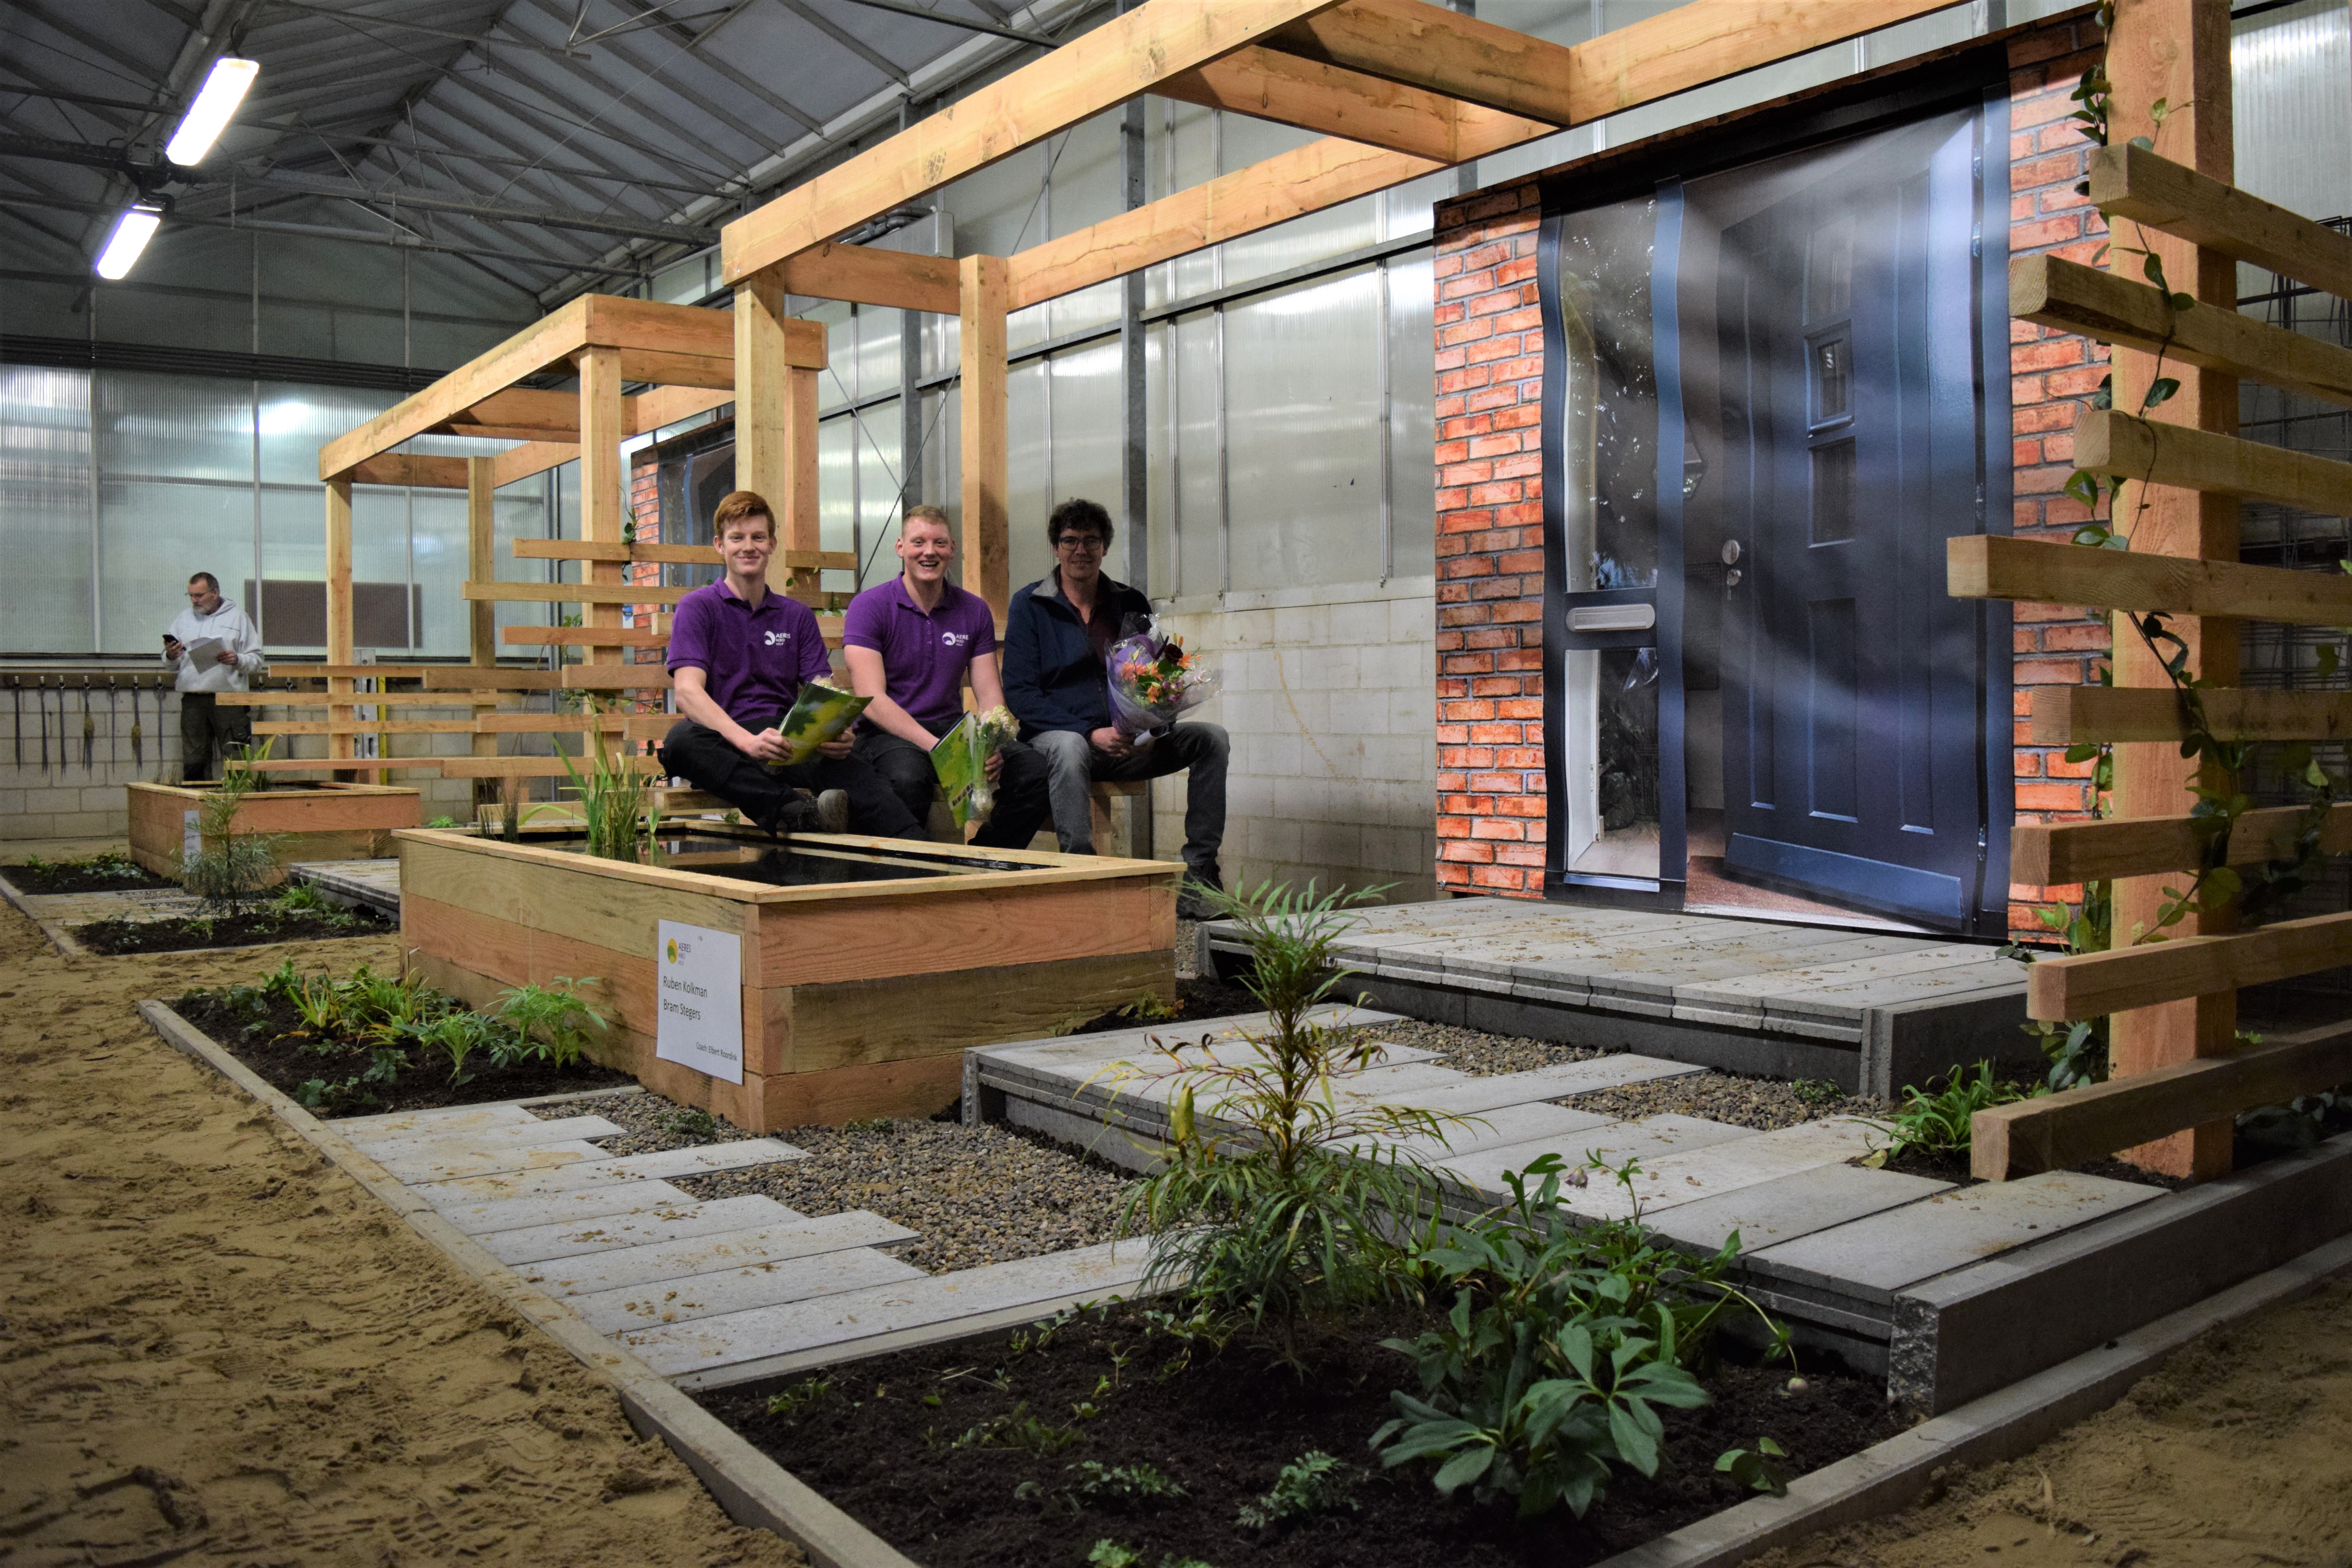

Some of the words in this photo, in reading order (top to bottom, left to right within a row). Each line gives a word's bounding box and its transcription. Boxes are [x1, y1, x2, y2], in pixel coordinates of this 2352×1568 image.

[678, 943, 691, 953] AERES
[663, 976, 682, 991] Ruben
[683, 980, 707, 998] Kolkman
[664, 999, 679, 1013] Bram
[680, 1004, 701, 1020] Stegers
[708, 1045, 720, 1056] Elbert
[720, 1049, 737, 1061] Roordink
